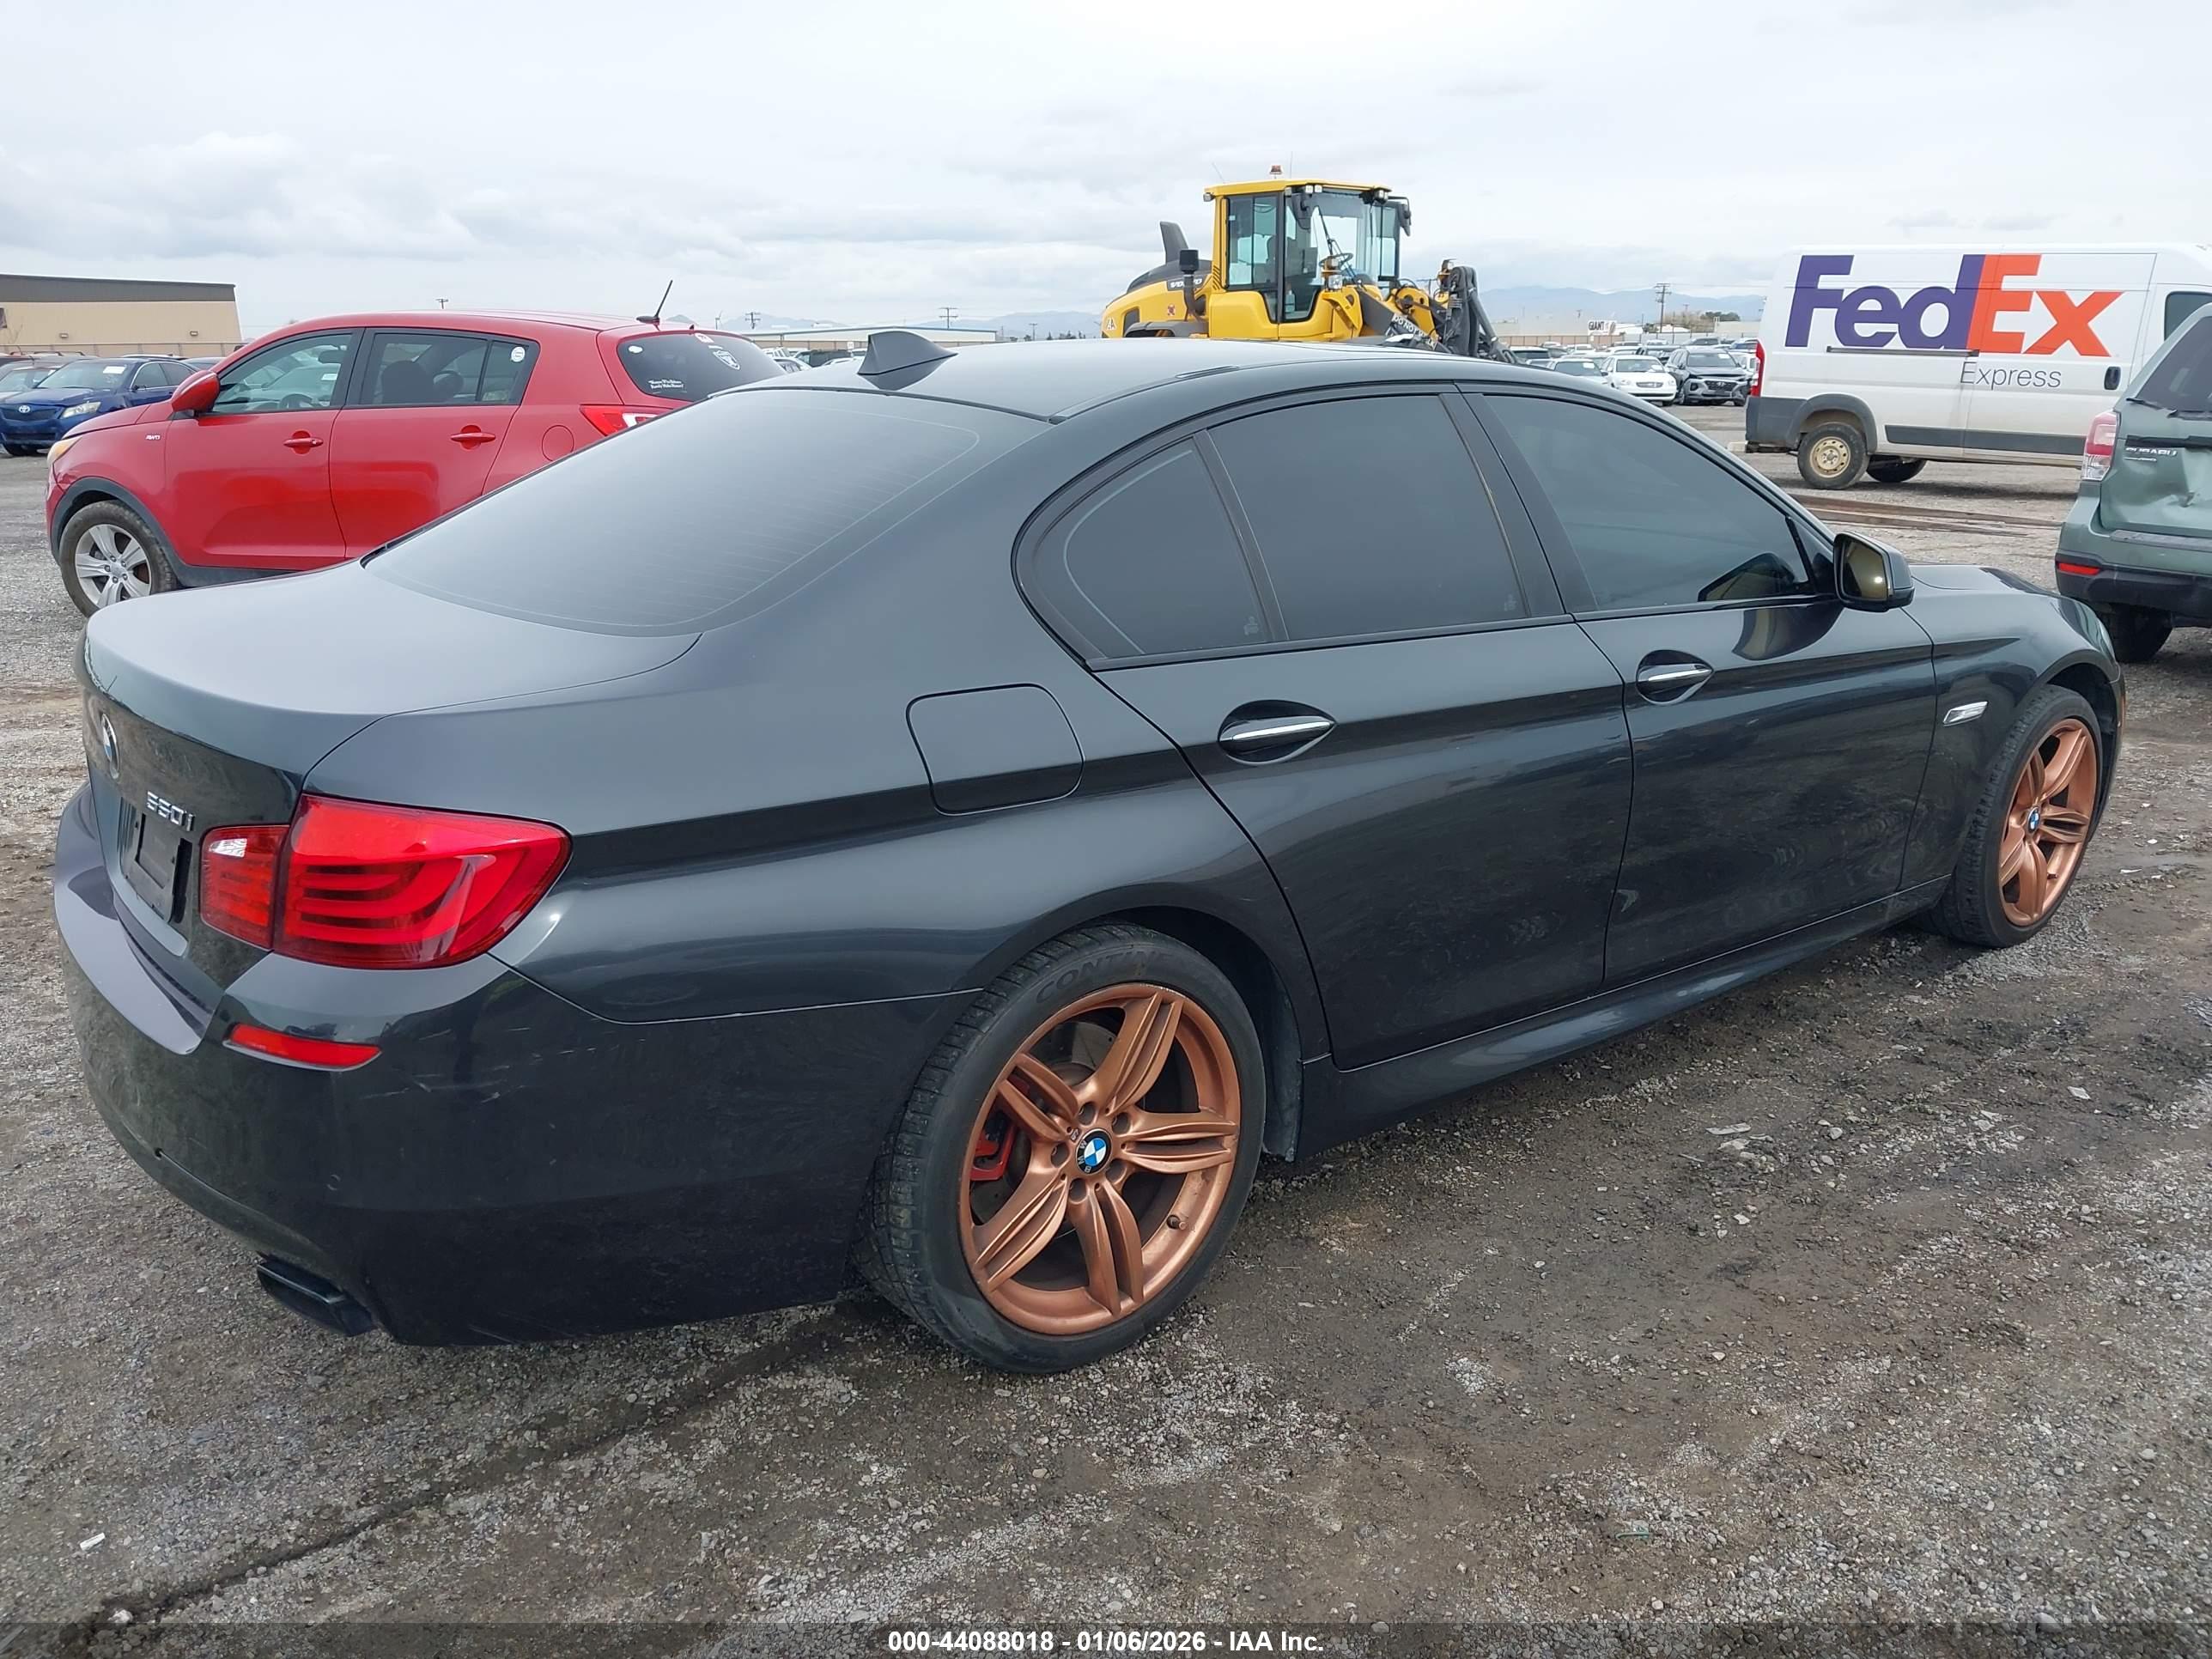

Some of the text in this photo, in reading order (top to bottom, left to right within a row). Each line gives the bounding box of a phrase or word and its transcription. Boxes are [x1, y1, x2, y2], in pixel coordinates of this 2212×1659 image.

[1785, 253, 2125, 357] FedEx
[1588, 320, 1605, 331] GIANT
[1960, 360, 2063, 391] Express
[146, 790, 194, 832] 550i
